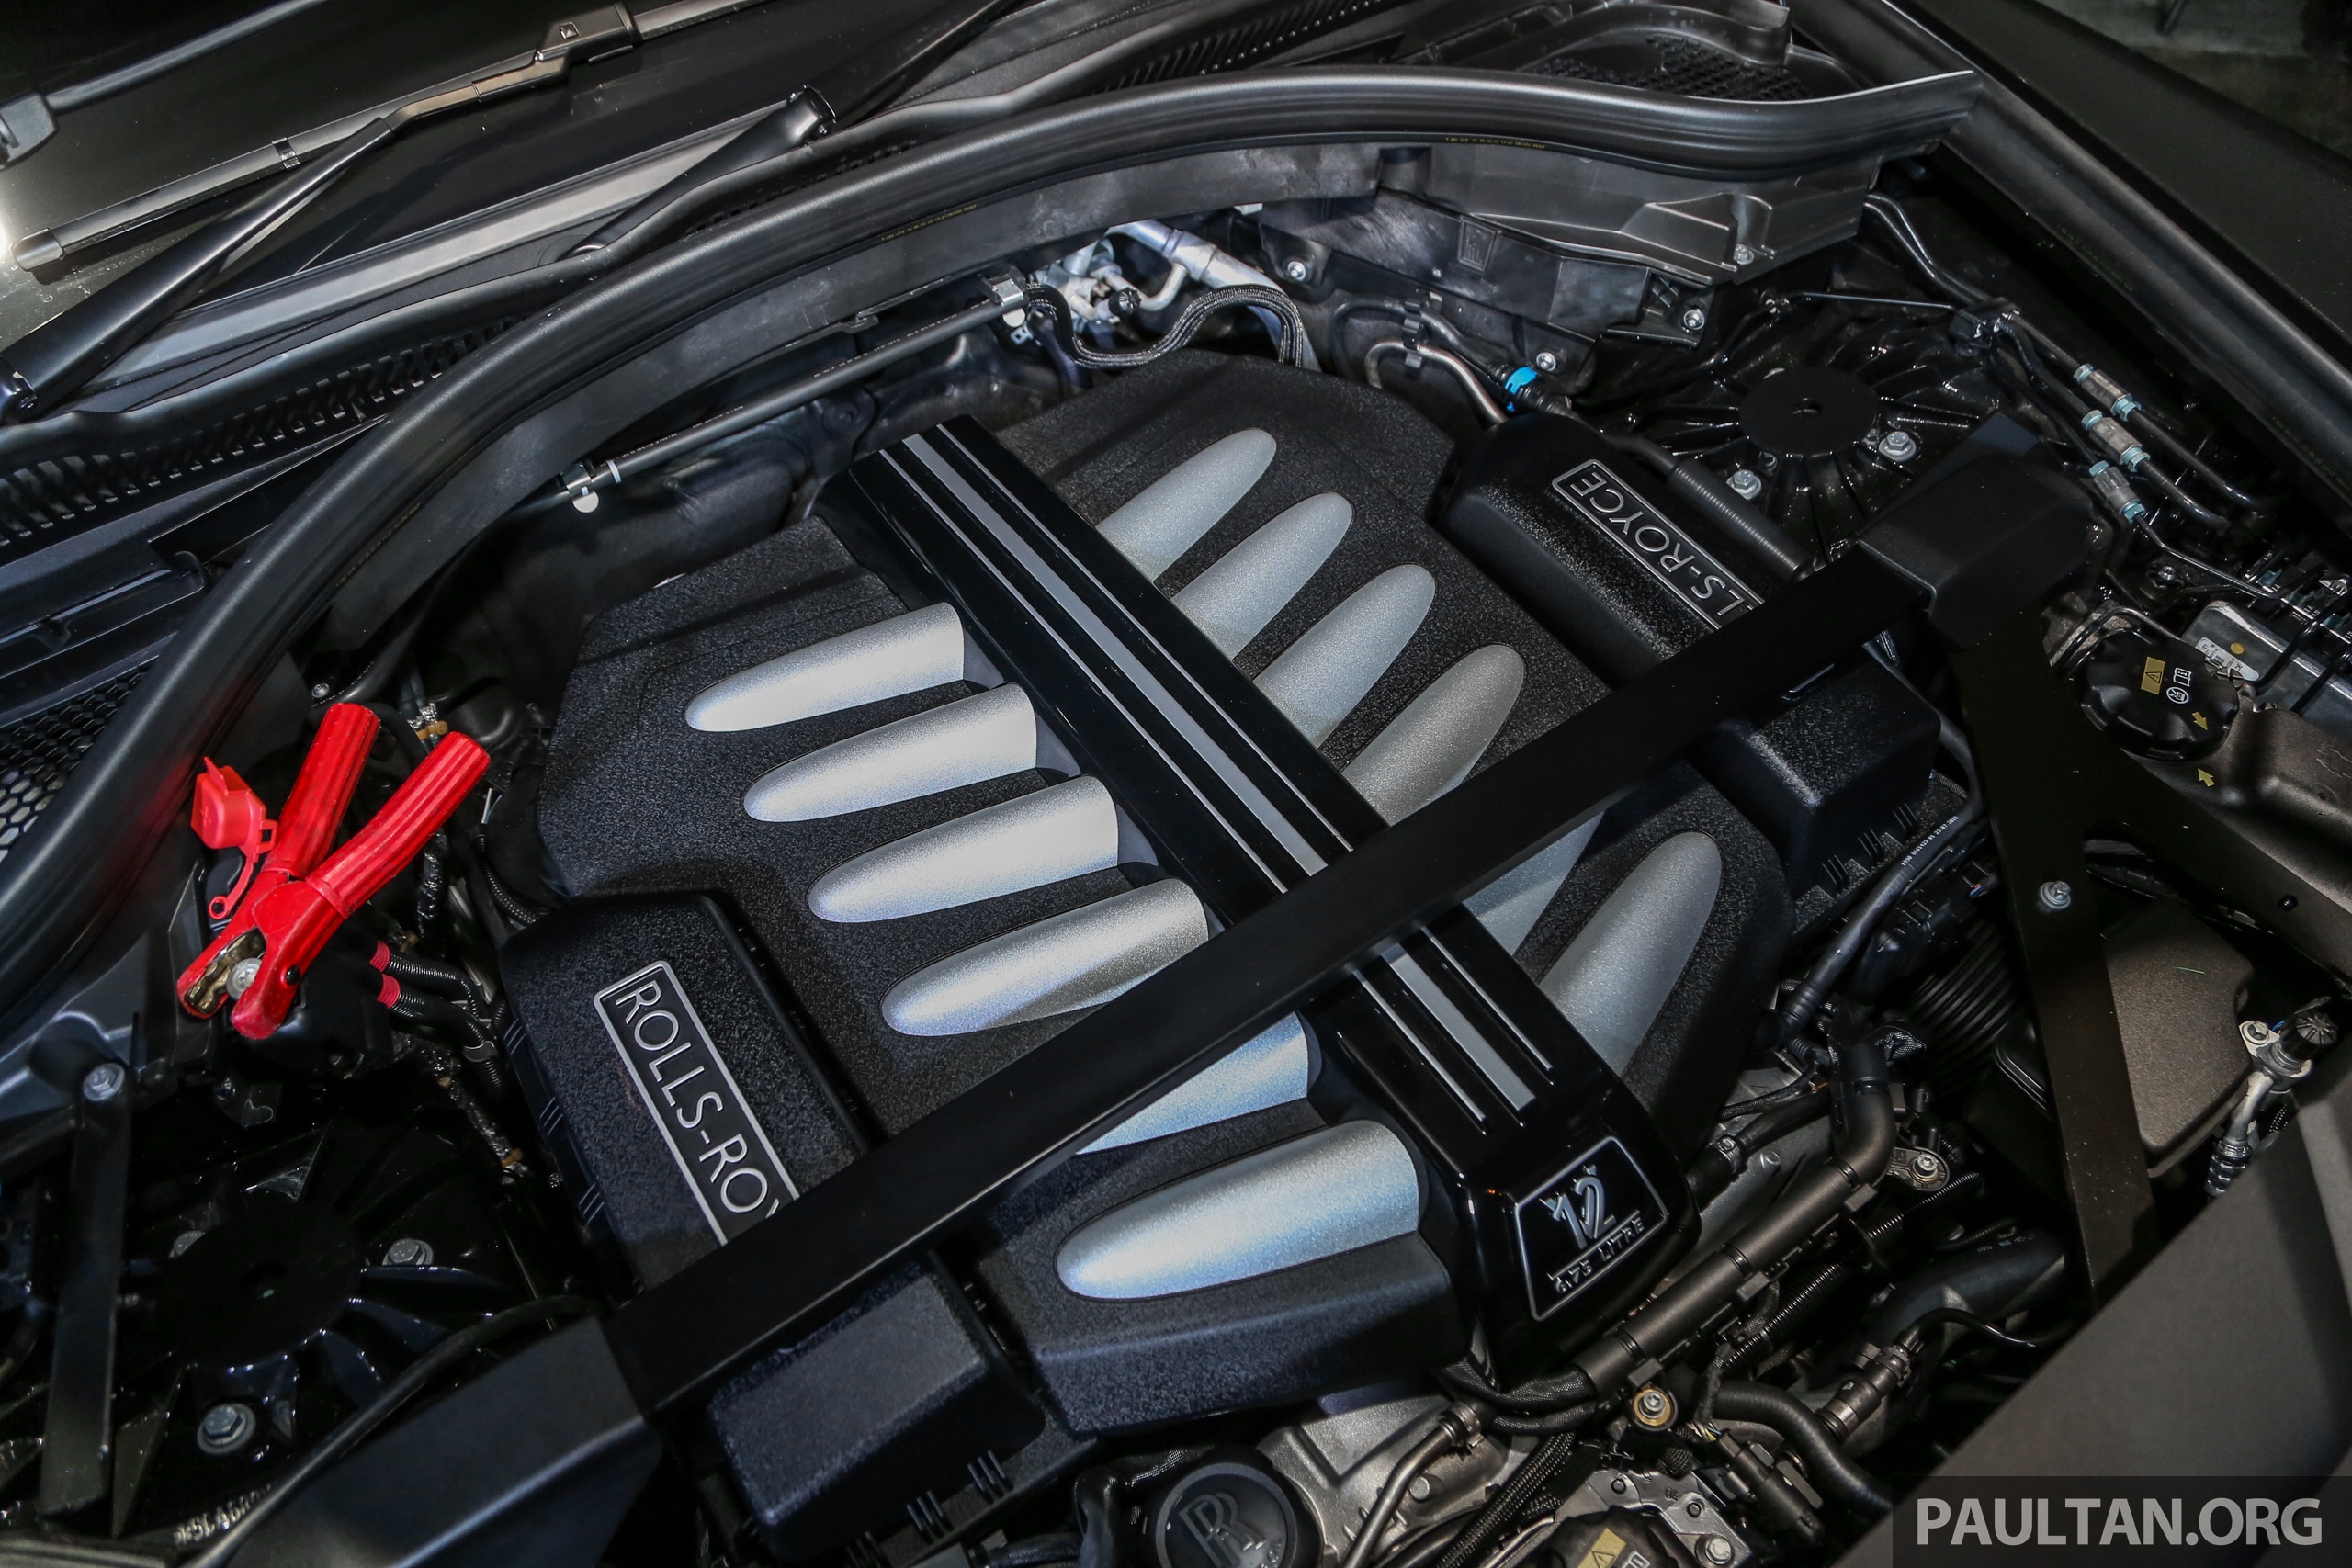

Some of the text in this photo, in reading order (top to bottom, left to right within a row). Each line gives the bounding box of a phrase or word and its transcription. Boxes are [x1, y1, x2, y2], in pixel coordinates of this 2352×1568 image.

[1570, 472, 1753, 616] LS-ROYCE
[616, 980, 779, 1218] ROLLS-RO
[1598, 1216, 1645, 1262] LITRE
